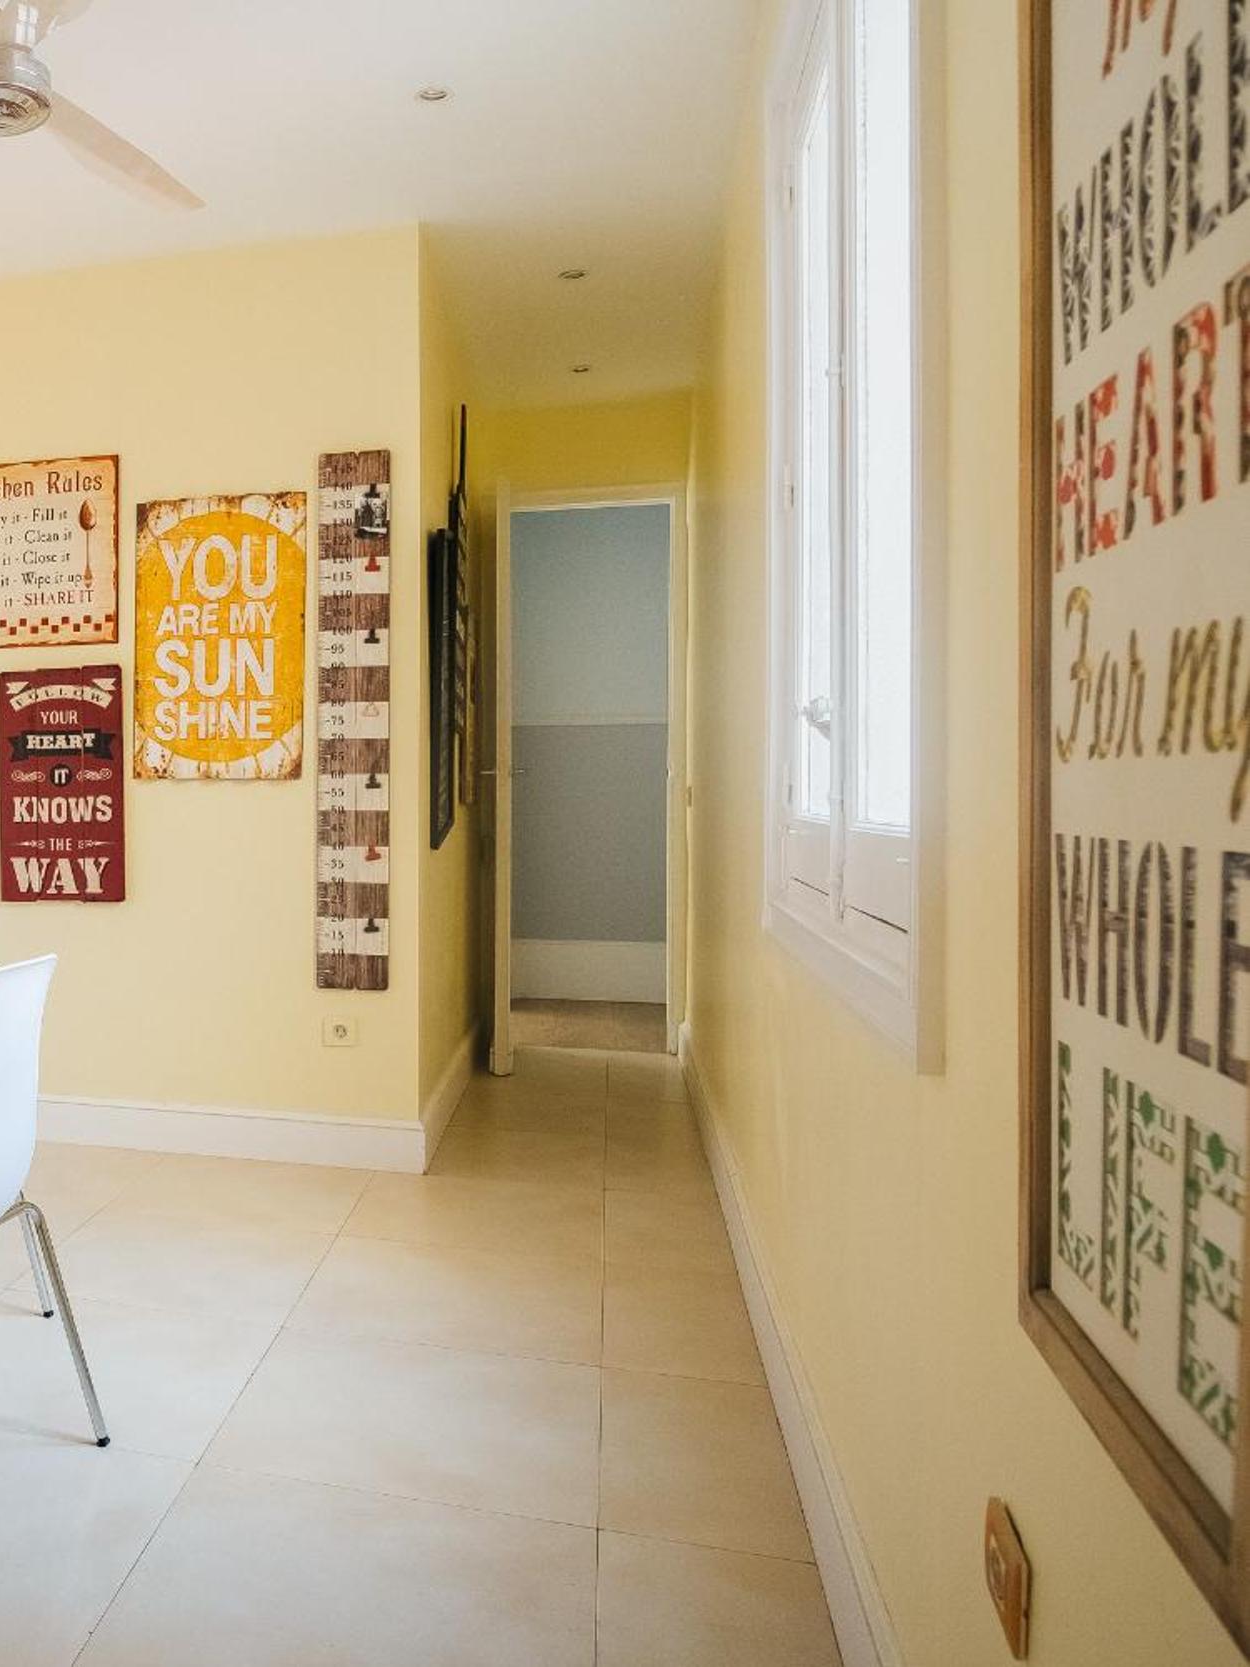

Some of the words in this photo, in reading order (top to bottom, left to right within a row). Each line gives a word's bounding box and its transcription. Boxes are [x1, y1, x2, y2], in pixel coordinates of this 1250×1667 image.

[47, 471, 102, 494] Rules
[12, 513, 20, 524] it
[32, 508, 54, 522] Fill
[59, 509, 68, 521] it
[4, 534, 13, 545] it
[24, 529, 59, 545] Clean
[64, 530, 72, 541] it
[3, 554, 11, 566] it
[22, 551, 57, 565] Close
[61, 552, 70, 562] it
[158, 534, 278, 600] YOU
[1, 575, 9, 587] it
[22, 572, 51, 587] Wipe
[55, 572, 63, 584] it
[67, 573, 82, 586] up
[4, 596, 13, 607] it
[24, 591, 75, 606] SHARE
[79, 589, 94, 603] IT
[157, 602, 218, 636] ARE
[229, 601, 277, 634] MY
[153, 639, 274, 698] SUN
[40, 710, 78, 725] YOUR
[153, 700, 272, 741] SHINE
[26, 733, 95, 749] HEART
[54, 769, 68, 784] IT
[13, 795, 112, 823] KNOWS
[49, 838, 72, 850] THE
[10, 857, 109, 895] WAY
[1055, 833, 1249, 1088] WHOLE
